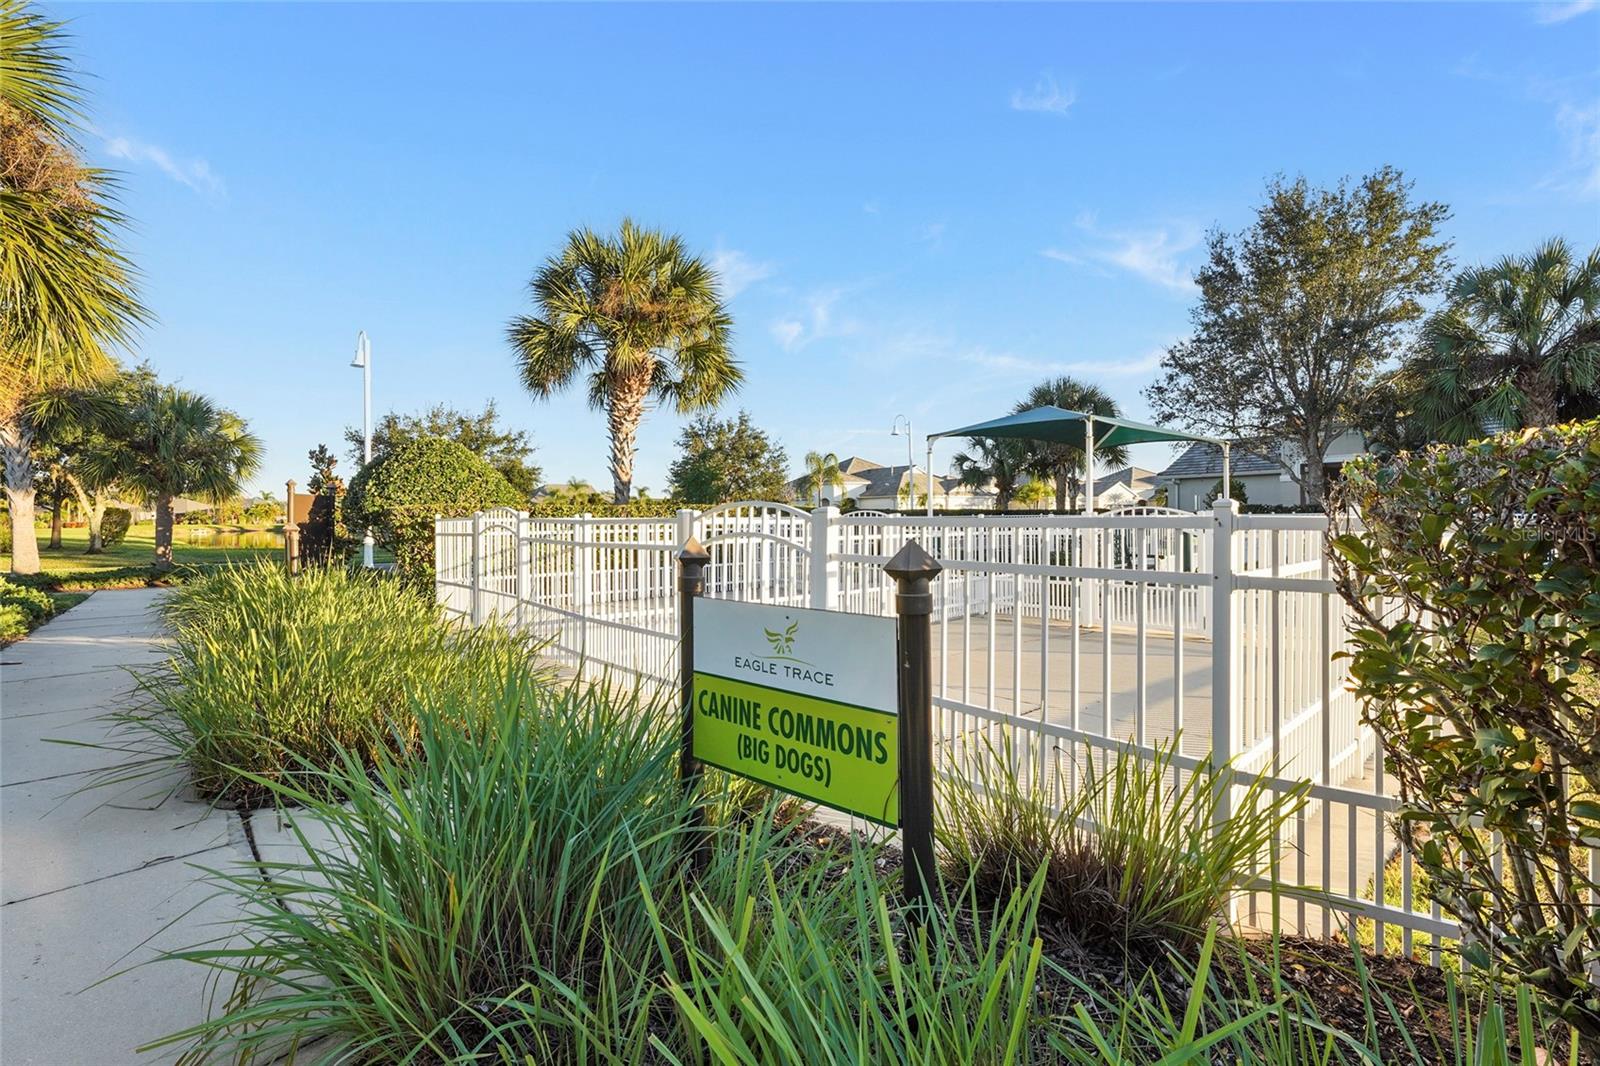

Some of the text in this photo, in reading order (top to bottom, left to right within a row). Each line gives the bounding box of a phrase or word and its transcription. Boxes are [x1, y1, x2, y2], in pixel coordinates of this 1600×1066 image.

[734, 656, 834, 687] EAGLE TRACE
[698, 689, 888, 765] CANINE COMMONS
[737, 733, 832, 788] (BIG DOGS)
